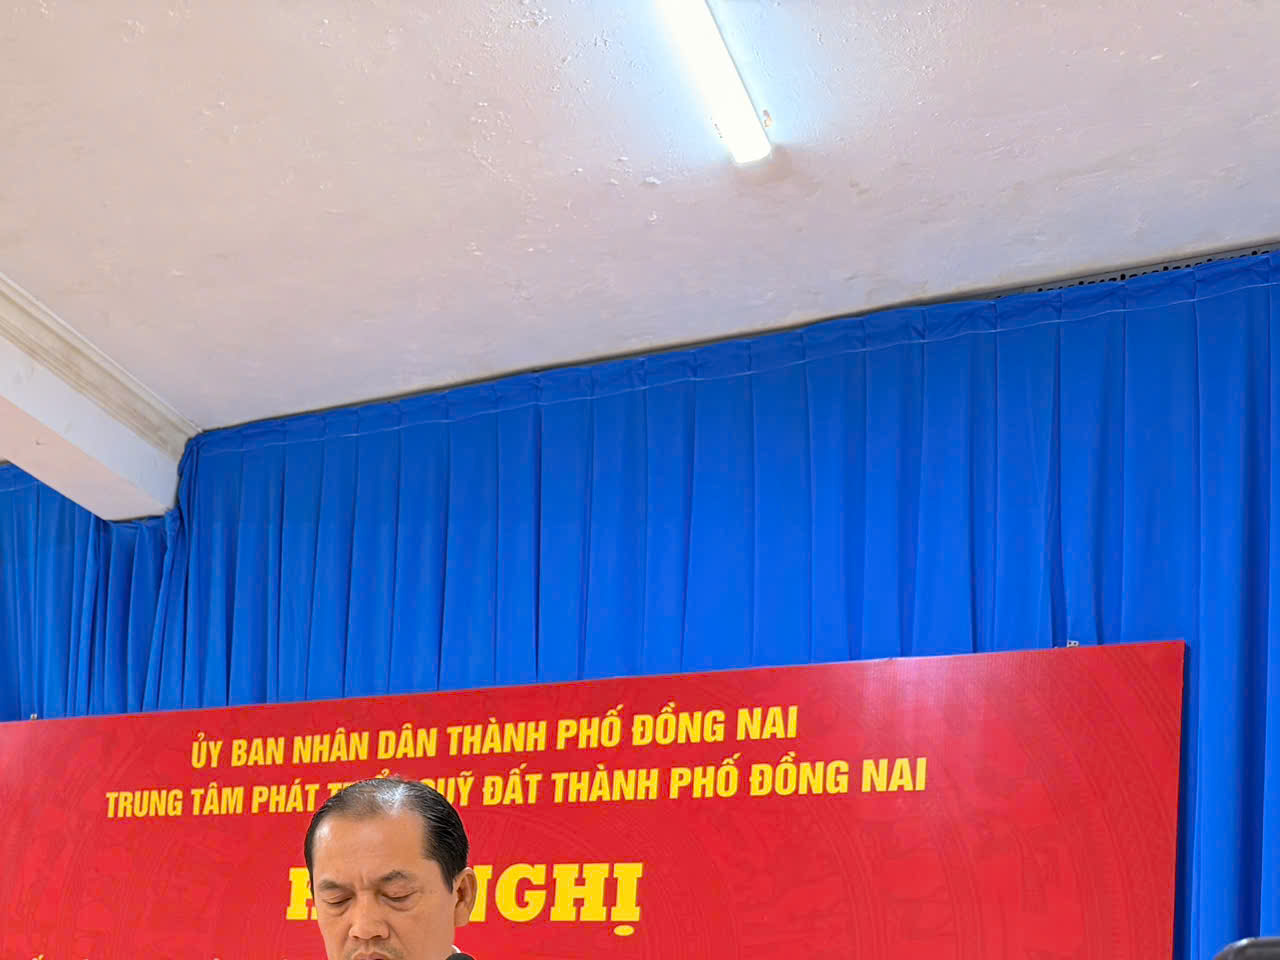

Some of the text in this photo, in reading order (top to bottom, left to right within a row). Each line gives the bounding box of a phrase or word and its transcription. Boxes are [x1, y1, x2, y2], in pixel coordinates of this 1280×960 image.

[191, 703, 799, 769] ỦY BAN NHÂN DÂN THÀNH PHỐ ĐỒNG NAI
[105, 788, 184, 819] TRUNG
[191, 781, 245, 816] TÂM
[251, 778, 321, 814] PHÁT
[482, 762, 543, 806] ĐẤT
[551, 763, 660, 804] THÀNH
[669, 752, 741, 800] PHỐ
[748, 751, 849, 797] ĐỒNG
[861, 757, 928, 793] NAI
